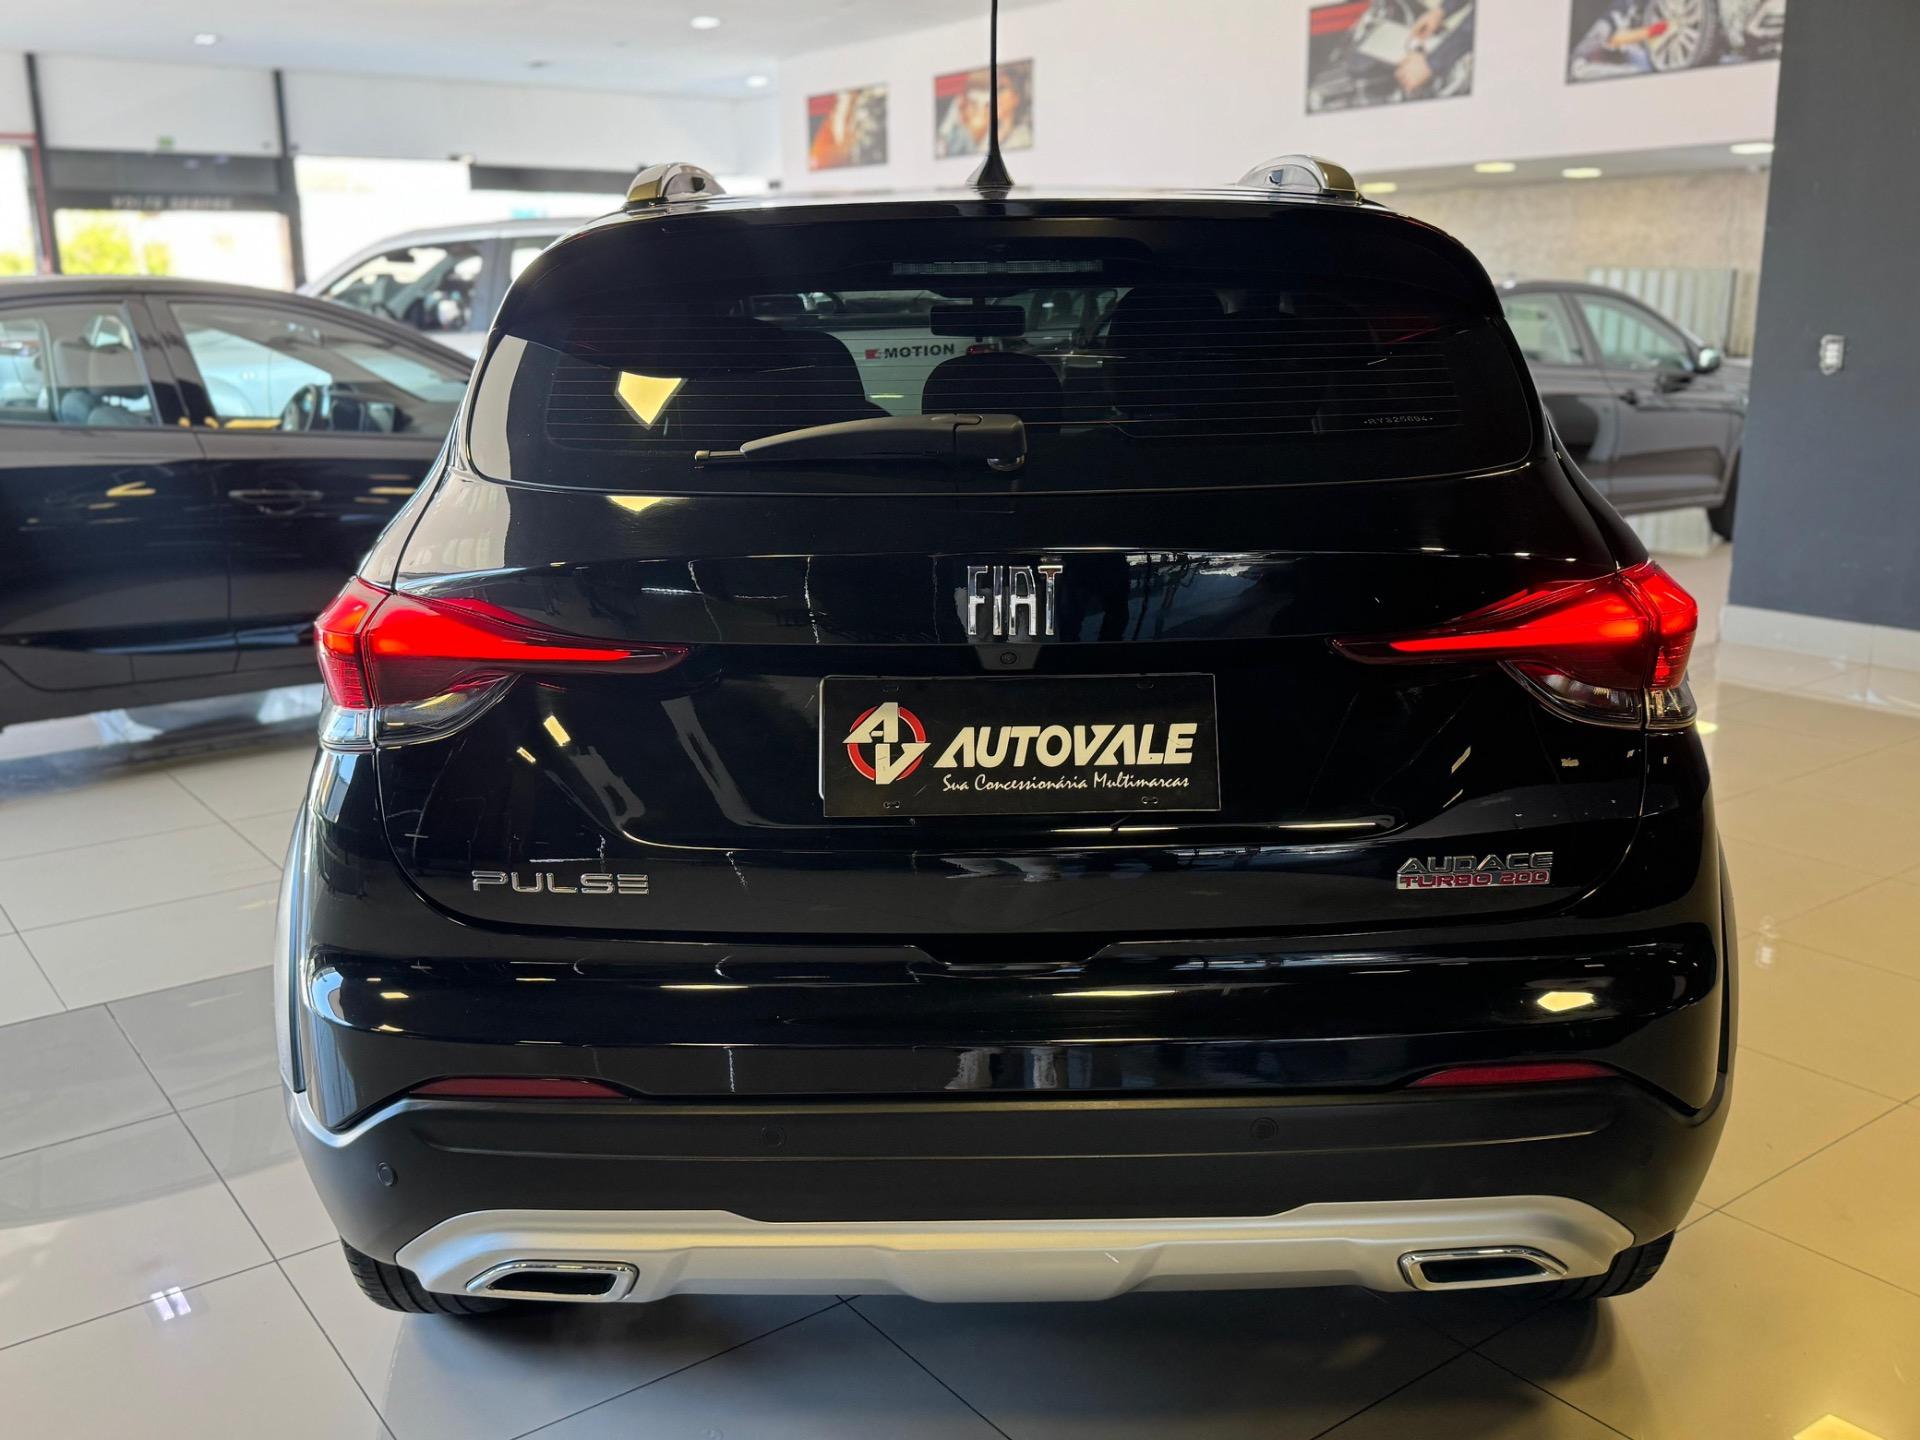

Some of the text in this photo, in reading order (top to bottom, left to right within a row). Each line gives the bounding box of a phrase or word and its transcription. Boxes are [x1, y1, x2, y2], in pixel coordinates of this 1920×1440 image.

[967, 565, 1063, 636] FIAT
[933, 722, 1198, 768] AUTOVALE
[942, 771, 1189, 792] Sua Concessionária Multimarcas
[1397, 852, 1553, 873] AUDACE
[471, 870, 650, 895] PULSE
[1399, 871, 1550, 888] TURBO 200
